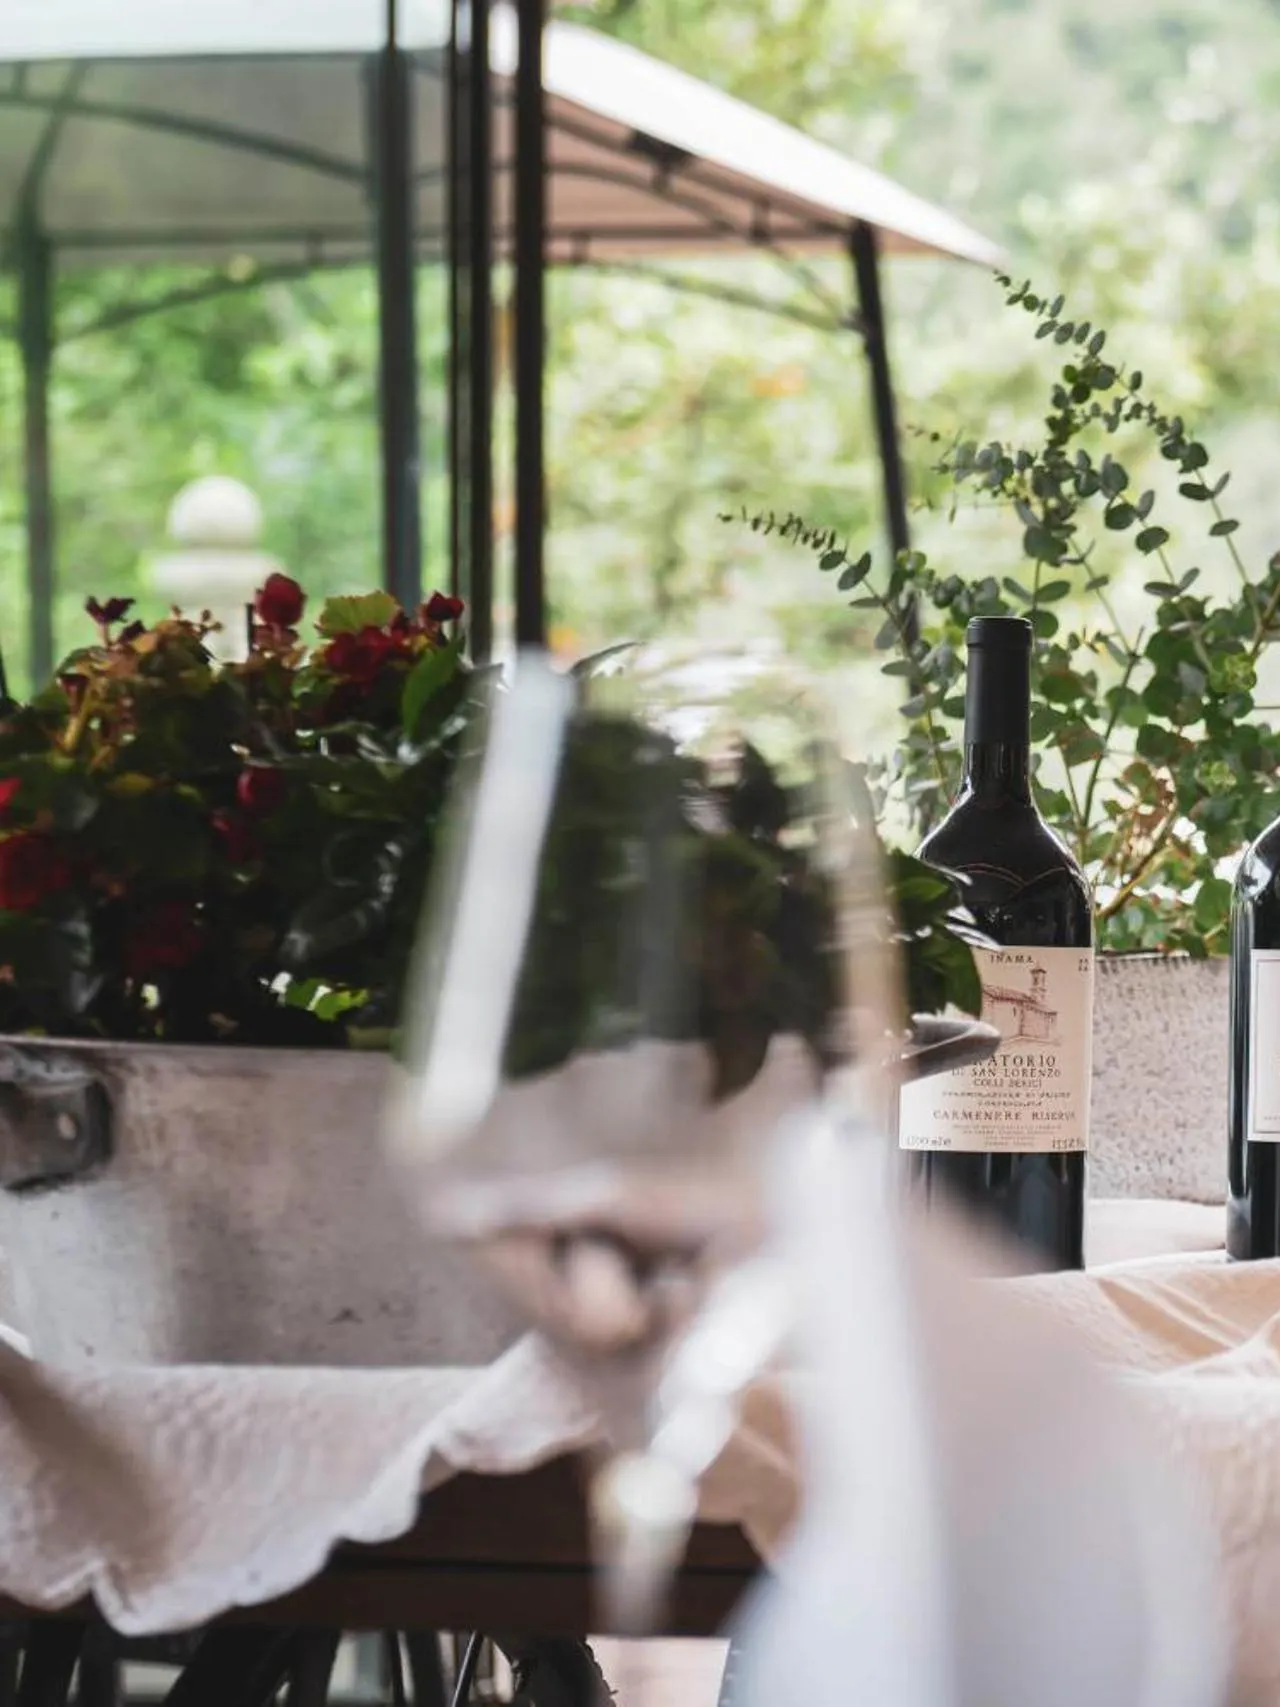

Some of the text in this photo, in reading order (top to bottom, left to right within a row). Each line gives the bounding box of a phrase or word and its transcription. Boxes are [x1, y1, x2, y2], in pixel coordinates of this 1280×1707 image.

[973, 1054, 1057, 1068] ATORIO
[971, 1067, 997, 1078] SAN
[1004, 1067, 1061, 1078] LORENZO
